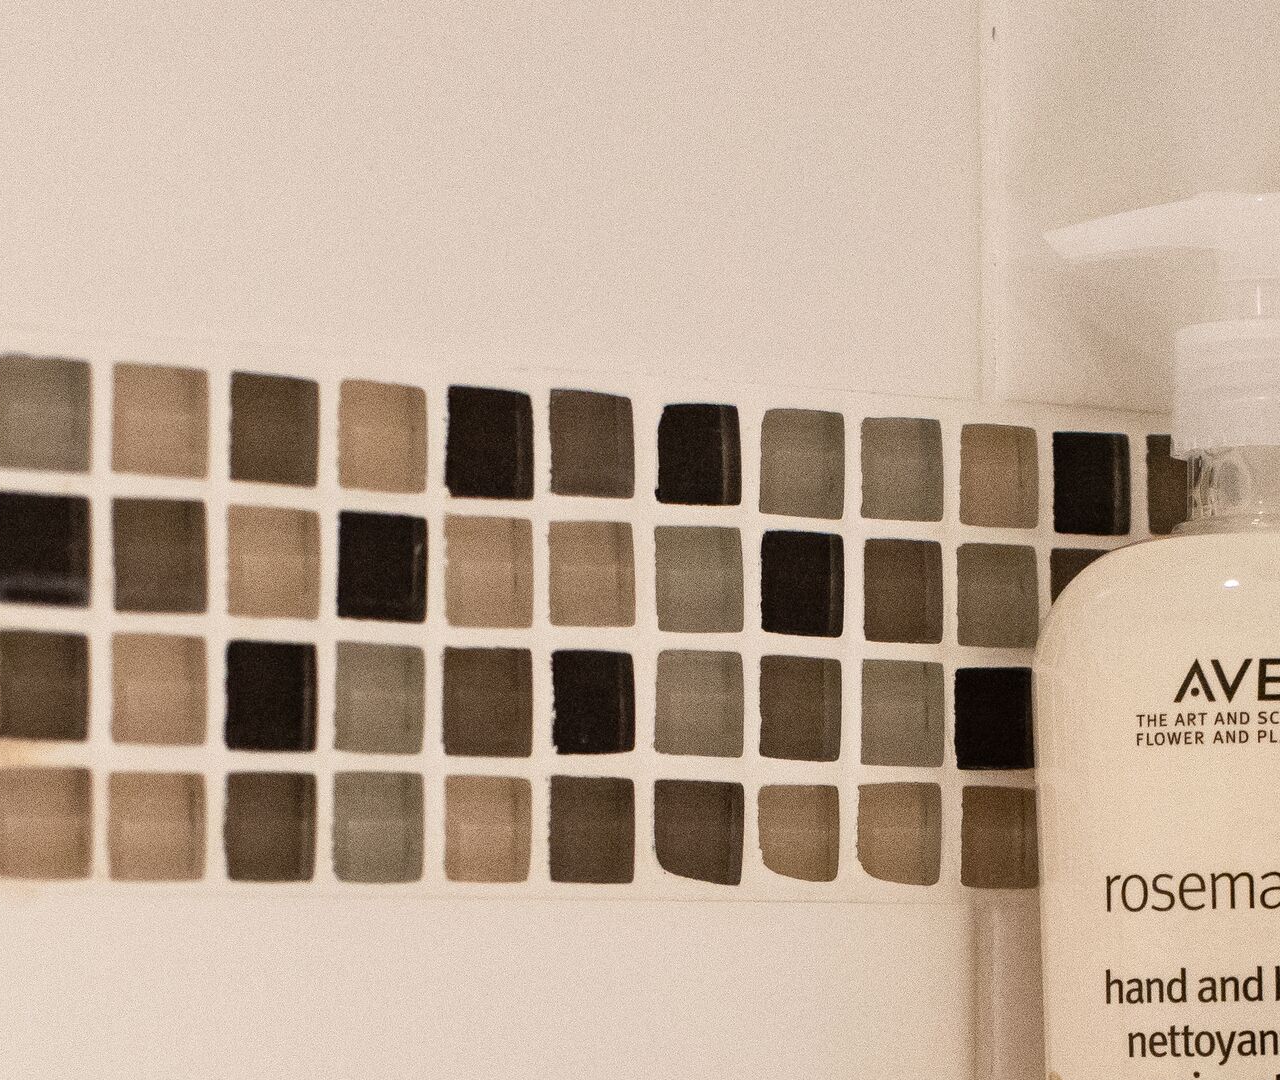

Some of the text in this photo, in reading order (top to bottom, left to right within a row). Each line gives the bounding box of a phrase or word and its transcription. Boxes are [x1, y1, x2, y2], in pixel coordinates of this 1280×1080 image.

[1136, 713, 1168, 728] THE
[1174, 712, 1208, 727] ART
[1214, 711, 1251, 726] AND
[1135, 730, 1205, 747] FLOWER
[1213, 729, 1250, 745] AND
[1104, 966, 1188, 1005] hand
[1197, 964, 1264, 1004] and
